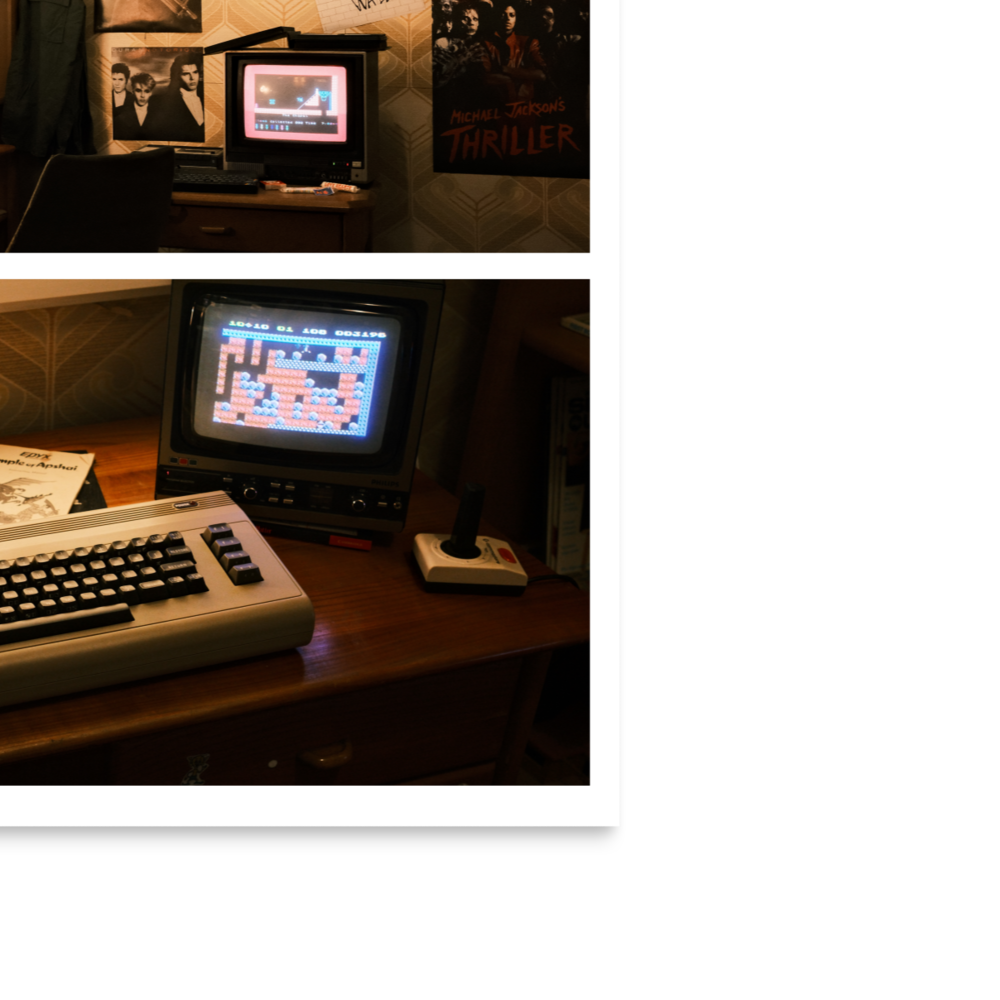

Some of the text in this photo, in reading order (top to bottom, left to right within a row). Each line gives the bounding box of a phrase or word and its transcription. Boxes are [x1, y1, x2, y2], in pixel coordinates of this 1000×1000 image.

[450, 96, 566, 125] MICHAEL JACKSON'S
[440, 123, 581, 164] THRILLER
[36, 462, 78, 470] Apshai
[371, 479, 399, 487] PHILIPS
